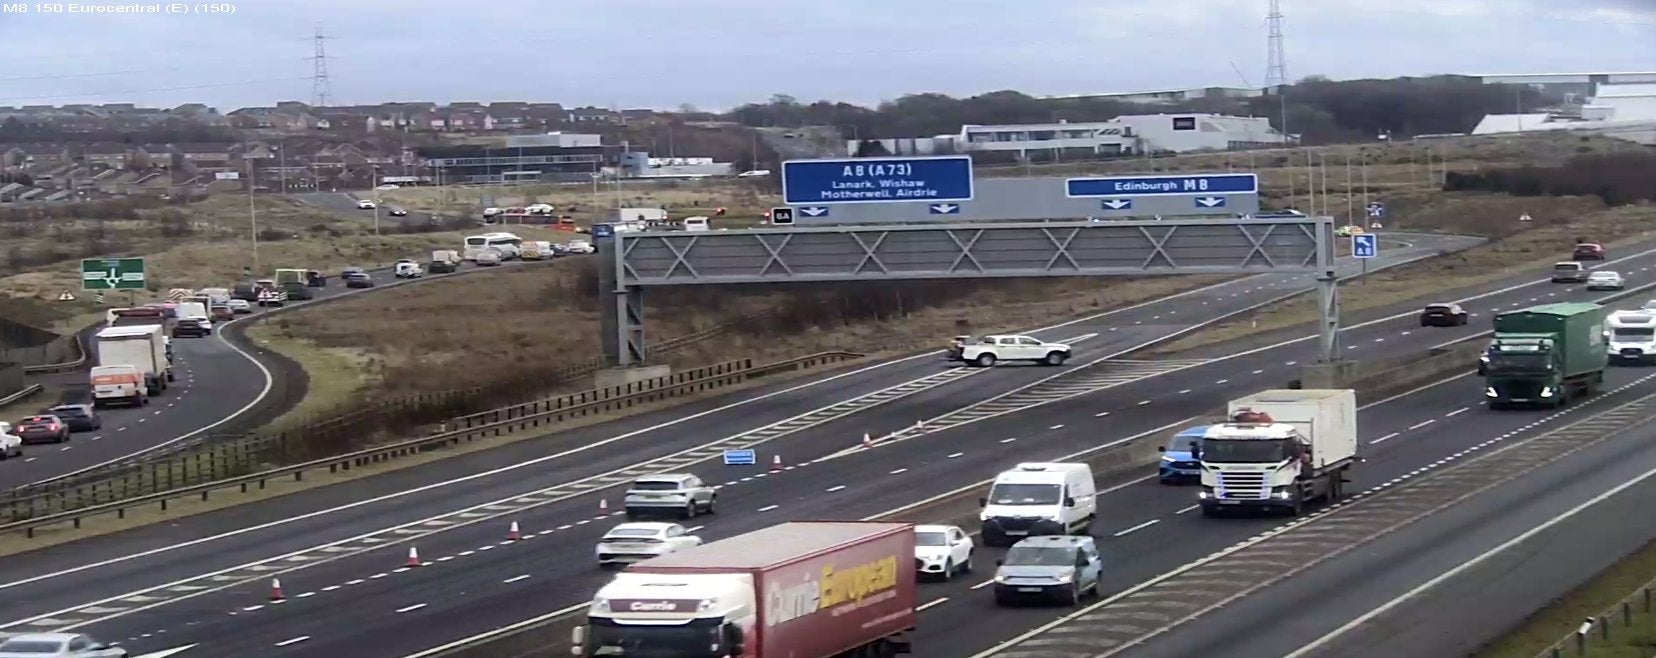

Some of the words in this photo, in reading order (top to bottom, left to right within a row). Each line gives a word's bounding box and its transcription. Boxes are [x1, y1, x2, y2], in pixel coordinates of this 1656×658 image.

[843, 165, 864, 177] A8
[868, 163, 912, 178] (A73)
[832, 180, 875, 190] Lanark,
[879, 179, 925, 188] Wishaw
[1114, 181, 1178, 192] Edinburgh
[1183, 179, 1209, 191] M8
[821, 190, 892, 200] Motherwell,
[896, 188, 938, 198] Airdrie
[765, 573, 820, 628] Currie
[819, 555, 897, 609] European
[630, 601, 677, 611] Currie
